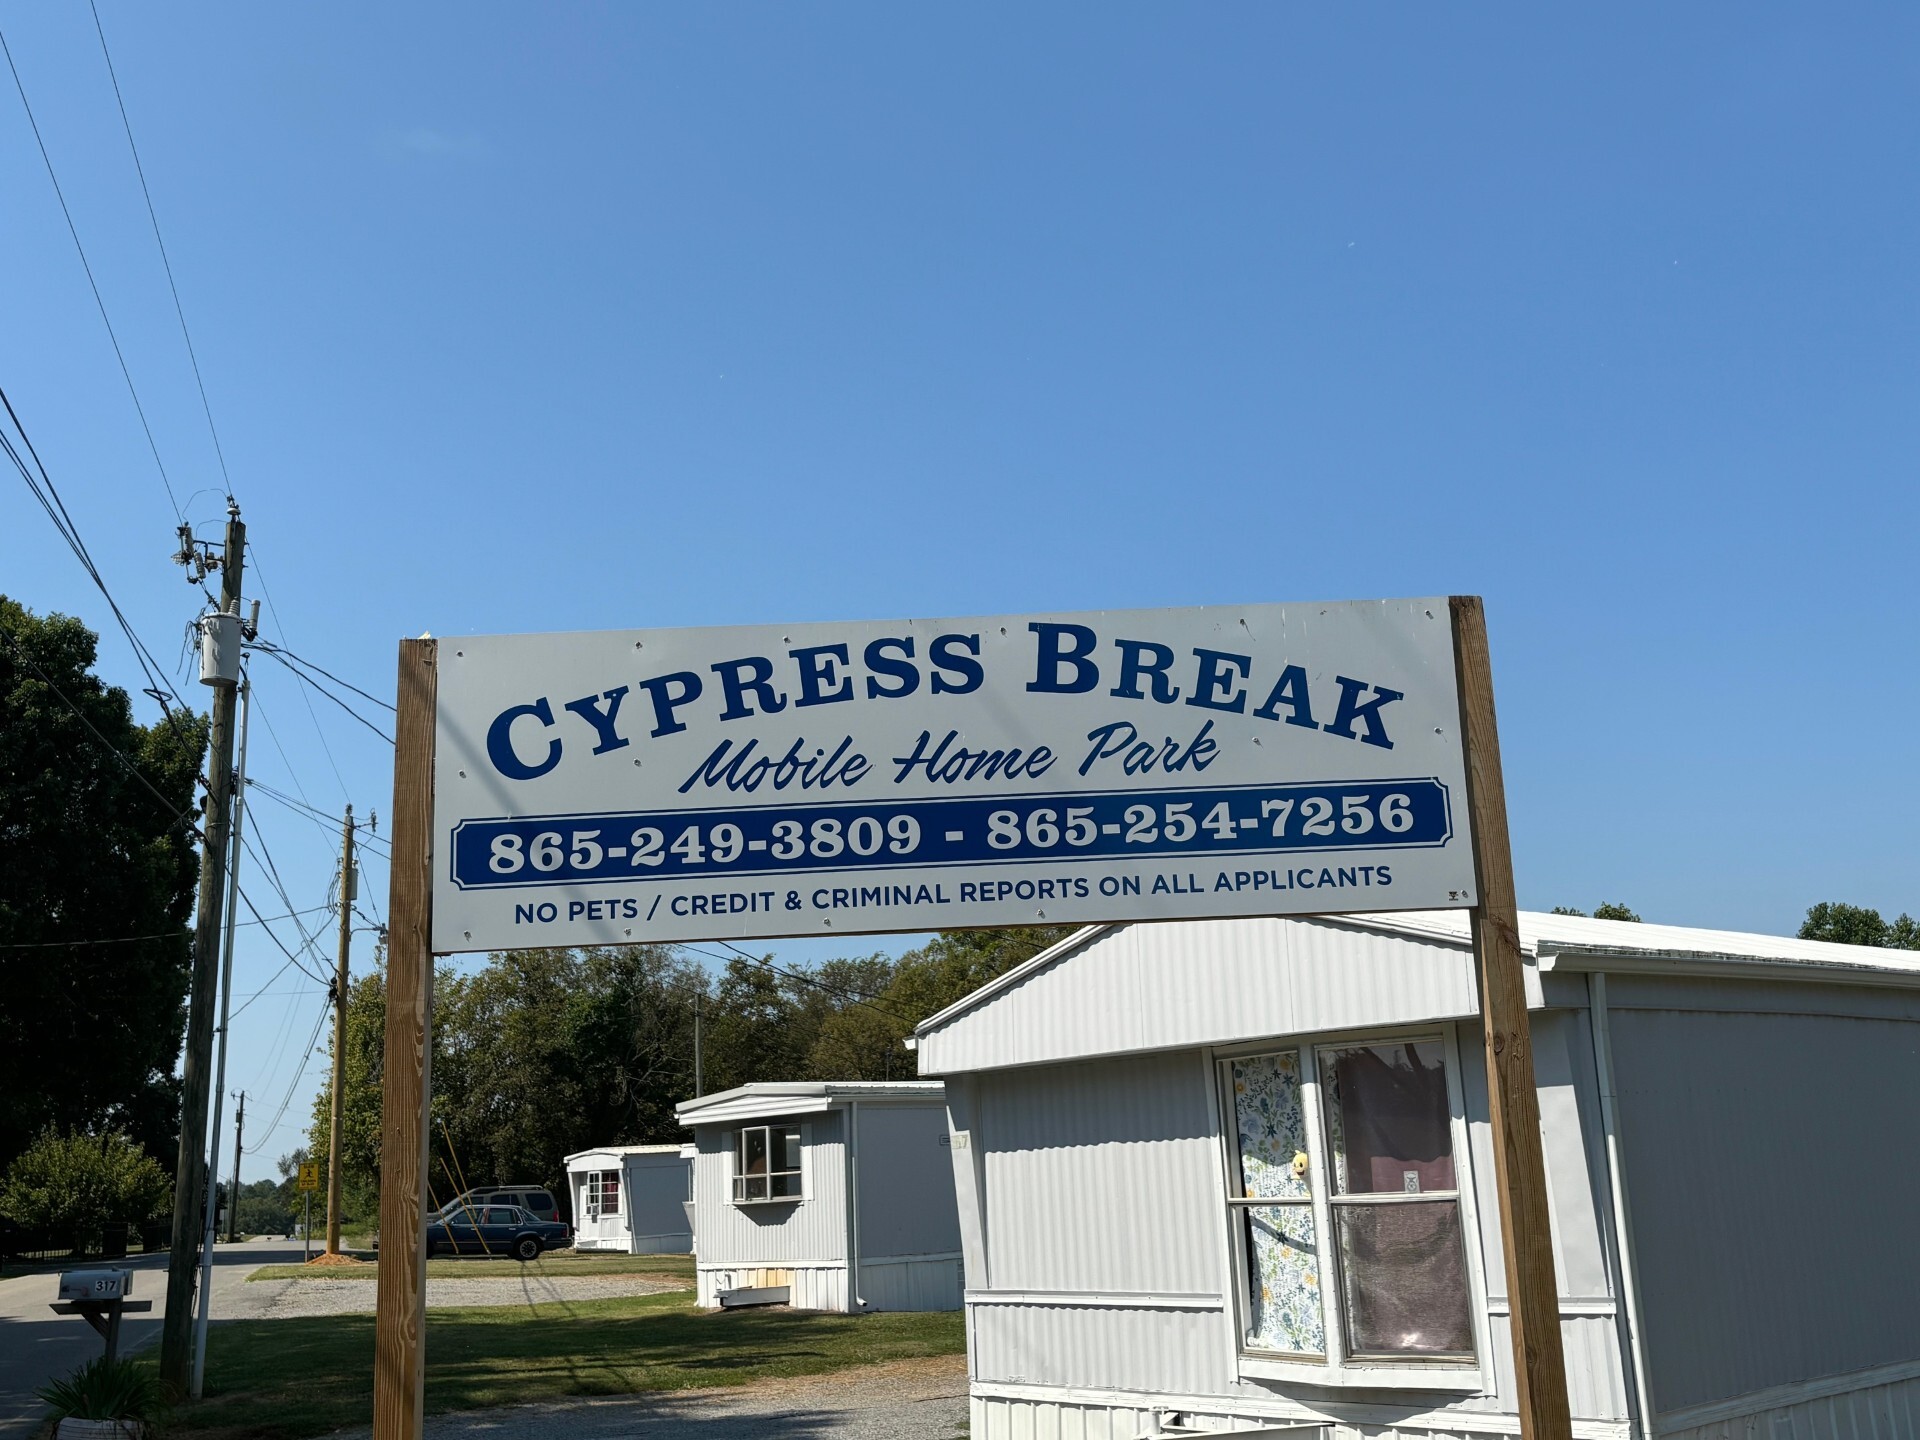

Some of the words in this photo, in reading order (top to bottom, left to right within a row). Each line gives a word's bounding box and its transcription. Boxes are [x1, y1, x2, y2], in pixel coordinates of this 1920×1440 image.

[486, 633, 985, 781] CYPRESS
[1025, 621, 1405, 751] BREAK
[677, 734, 874, 794] Mobile
[892, 729, 1058, 785] Home
[1077, 718, 1222, 777] Park
[488, 814, 921, 874] 865-249-3809
[945, 830, 964, 842] -
[987, 793, 1414, 850] 865-254-7256
[515, 902, 558, 925] NO
[568, 898, 638, 922] PETS
[646, 894, 662, 922] /
[670, 891, 776, 917] CREDIT
[784, 890, 803, 911] &
[811, 883, 951, 910] CRIMINAL
[959, 877, 1090, 903] REPORTS
[1098, 875, 1141, 897] ON
[1151, 873, 1205, 895] ALL
[1213, 865, 1393, 893] APPLICANTS
[96, 1280, 116, 1292] 317
